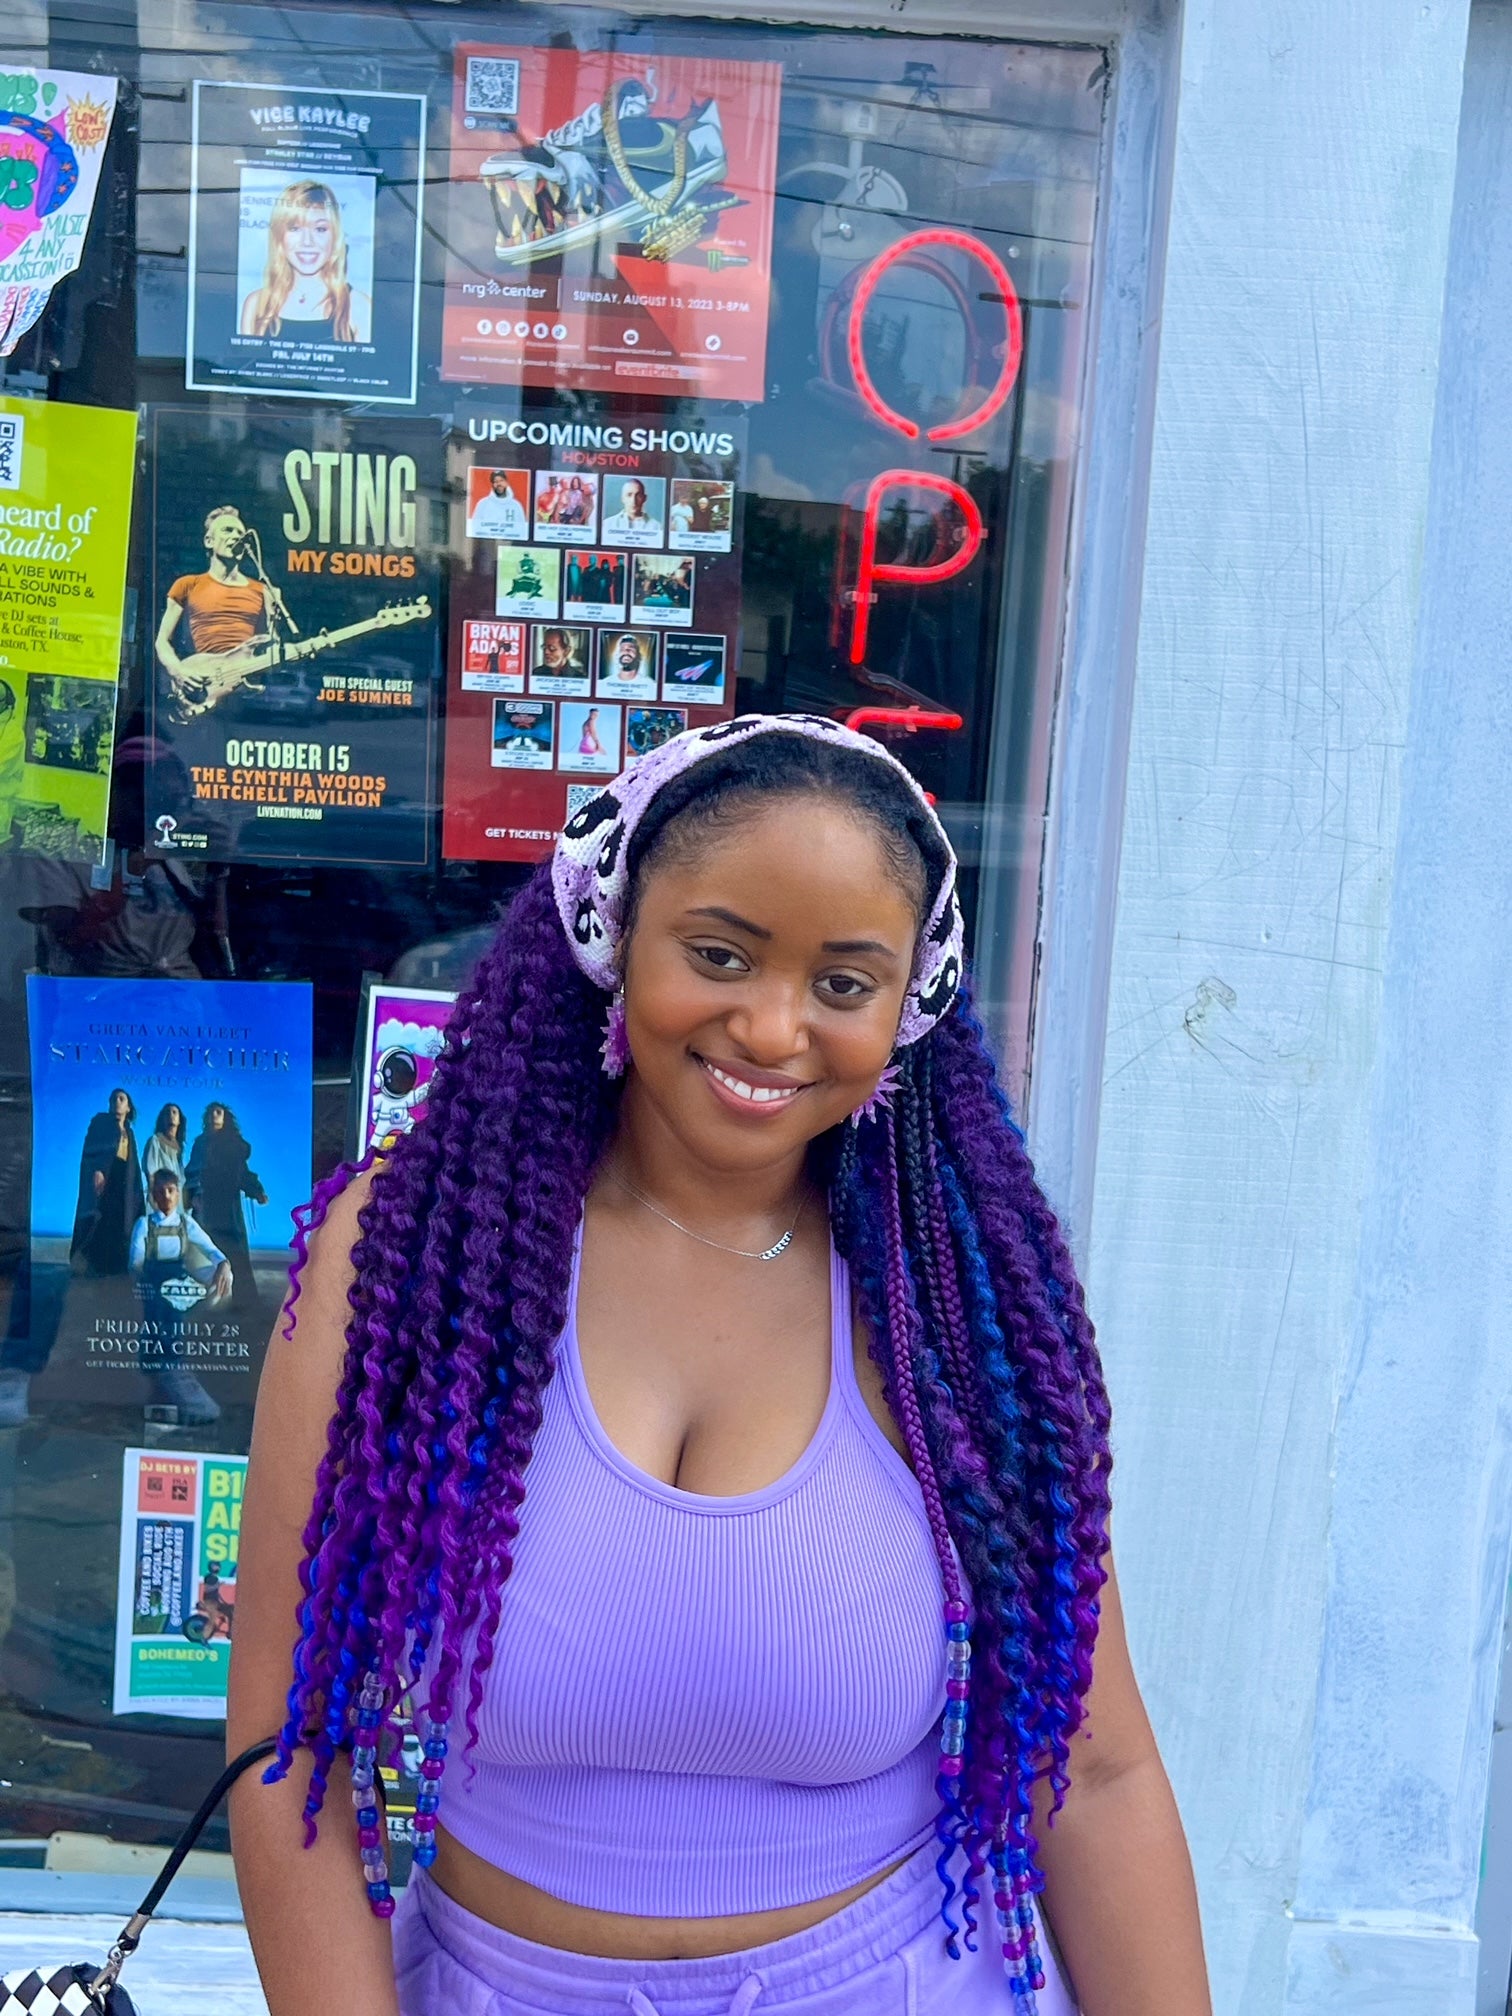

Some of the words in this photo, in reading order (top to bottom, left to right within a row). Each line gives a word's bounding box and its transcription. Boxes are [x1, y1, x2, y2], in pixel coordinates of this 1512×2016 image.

[250, 106, 295, 125] VICE
[298, 106, 371, 132] KAYLEE
[462, 284, 486, 298] nrg
[502, 286, 547, 299] center
[573, 290, 620, 305] SUNDAY,
[623, 296, 667, 307] AUGUST
[670, 297, 684, 309] 13,
[688, 299, 713, 310] 2023
[617, 364, 680, 378] eventbrite
[468, 418, 623, 450] UPCOMING
[630, 428, 734, 456] SHOWS
[562, 452, 640, 468] HOUSTON
[847, 227, 1024, 736] OP
[283, 449, 416, 548] STING
[68, 507, 97, 534] of
[13, 563, 46, 578] VIBE
[48, 567, 87, 583] WITH
[288, 550, 327, 573] MY
[330, 553, 416, 578] SONGS
[20, 579, 81, 597] SOUNDS
[84, 587, 95, 598] &
[0, 591, 57, 608] ATIONS
[11, 610, 24, 622] DJ
[26, 615, 47, 625] sets
[14, 624, 47, 639] Coffee
[470, 624, 519, 641] BRYAN
[322, 676, 346, 688] WITH
[348, 677, 383, 690] SPECIAL
[384, 679, 414, 692] GUEST
[316, 689, 346, 702] JOE
[348, 691, 412, 706] SUMNER
[226, 740, 322, 771] OCTOBER
[328, 744, 349, 772] 15
[190, 767, 226, 784] THE
[232, 770, 313, 787] CYNTHIA
[317, 773, 386, 792] WOODS
[194, 783, 288, 803] MITCHELL
[293, 788, 382, 807] PAVILION
[256, 806, 323, 820] LIVENATION.COM
[484, 828, 506, 838] GET
[508, 828, 552, 840] TICKETS
[88, 1023, 148, 1038] GRETA
[156, 1025, 190, 1038] VAN
[196, 1026, 253, 1040] FLEET
[50, 1042, 290, 1072] STARCATCHER
[120, 1074, 179, 1088] WORLD
[182, 1077, 224, 1090] TOUR
[160, 1286, 207, 1296] KALEO
[94, 1318, 166, 1336] FRIDAY,
[172, 1321, 214, 1338] JULY
[220, 1324, 240, 1338] 28
[87, 1336, 165, 1355] TOYOTA
[171, 1341, 250, 1358] CENTER
[106, 1361, 140, 1369] TICKETS
[140, 1462, 154, 1472] DJ
[155, 1463, 182, 1474] SETS
[183, 1466, 196, 1476] BY
[143, 1526, 153, 1555] BIKES
[142, 1556, 152, 1576] AND
[140, 1578, 152, 1616] COFFEE
[138, 1648, 218, 1662] BOHEMEO'S
